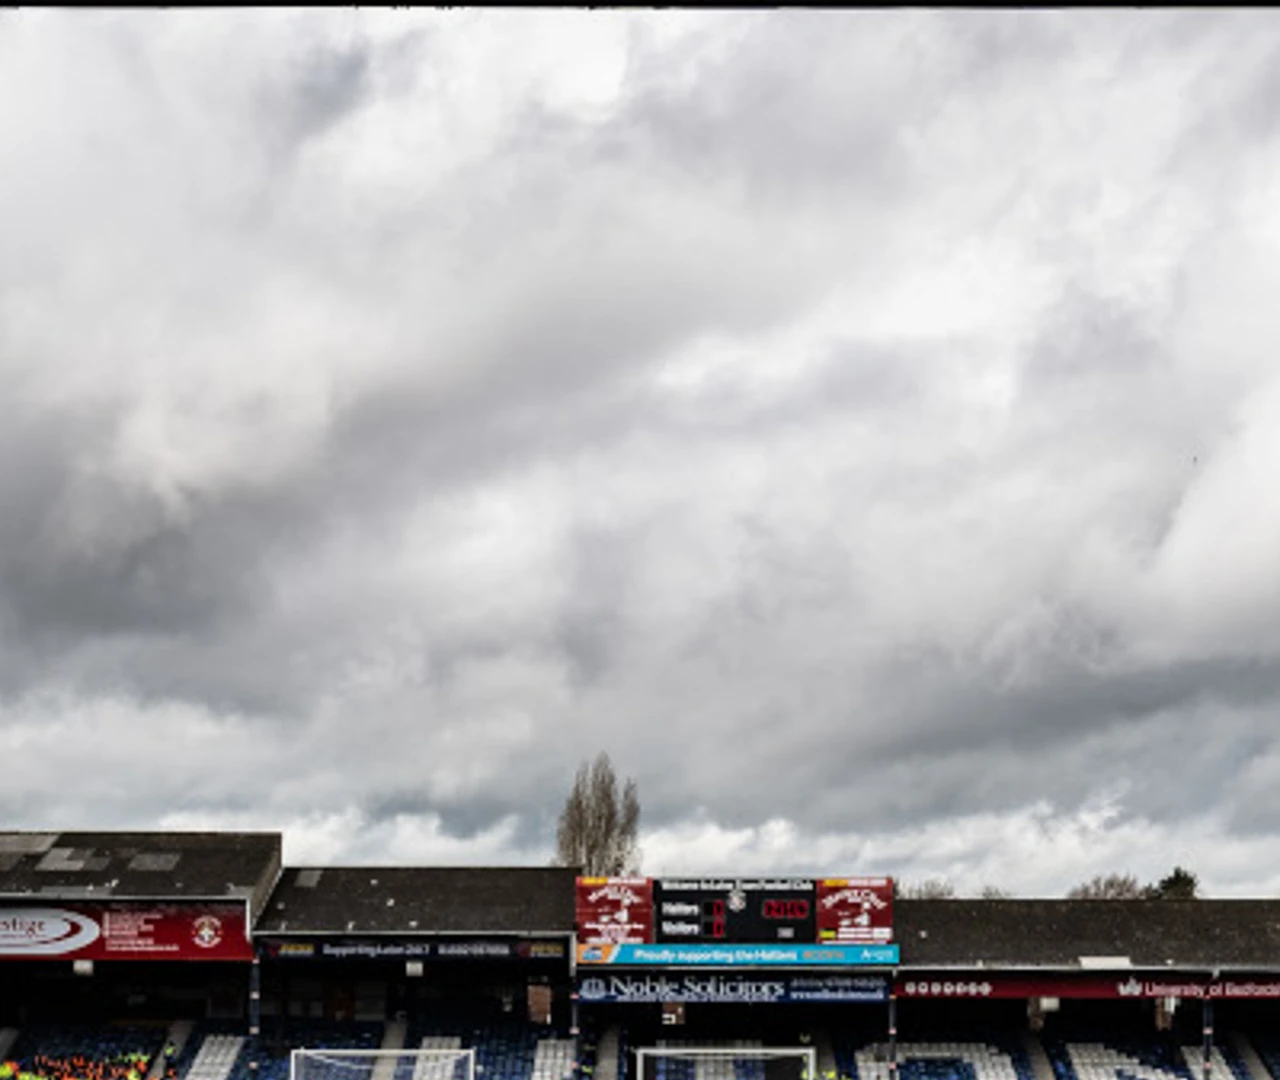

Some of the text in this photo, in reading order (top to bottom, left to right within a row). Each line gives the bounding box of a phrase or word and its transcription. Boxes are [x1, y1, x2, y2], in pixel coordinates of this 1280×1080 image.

[610, 976, 679, 996] Noble
[680, 975, 785, 996] Solicitors
[1145, 983, 1206, 997] University
